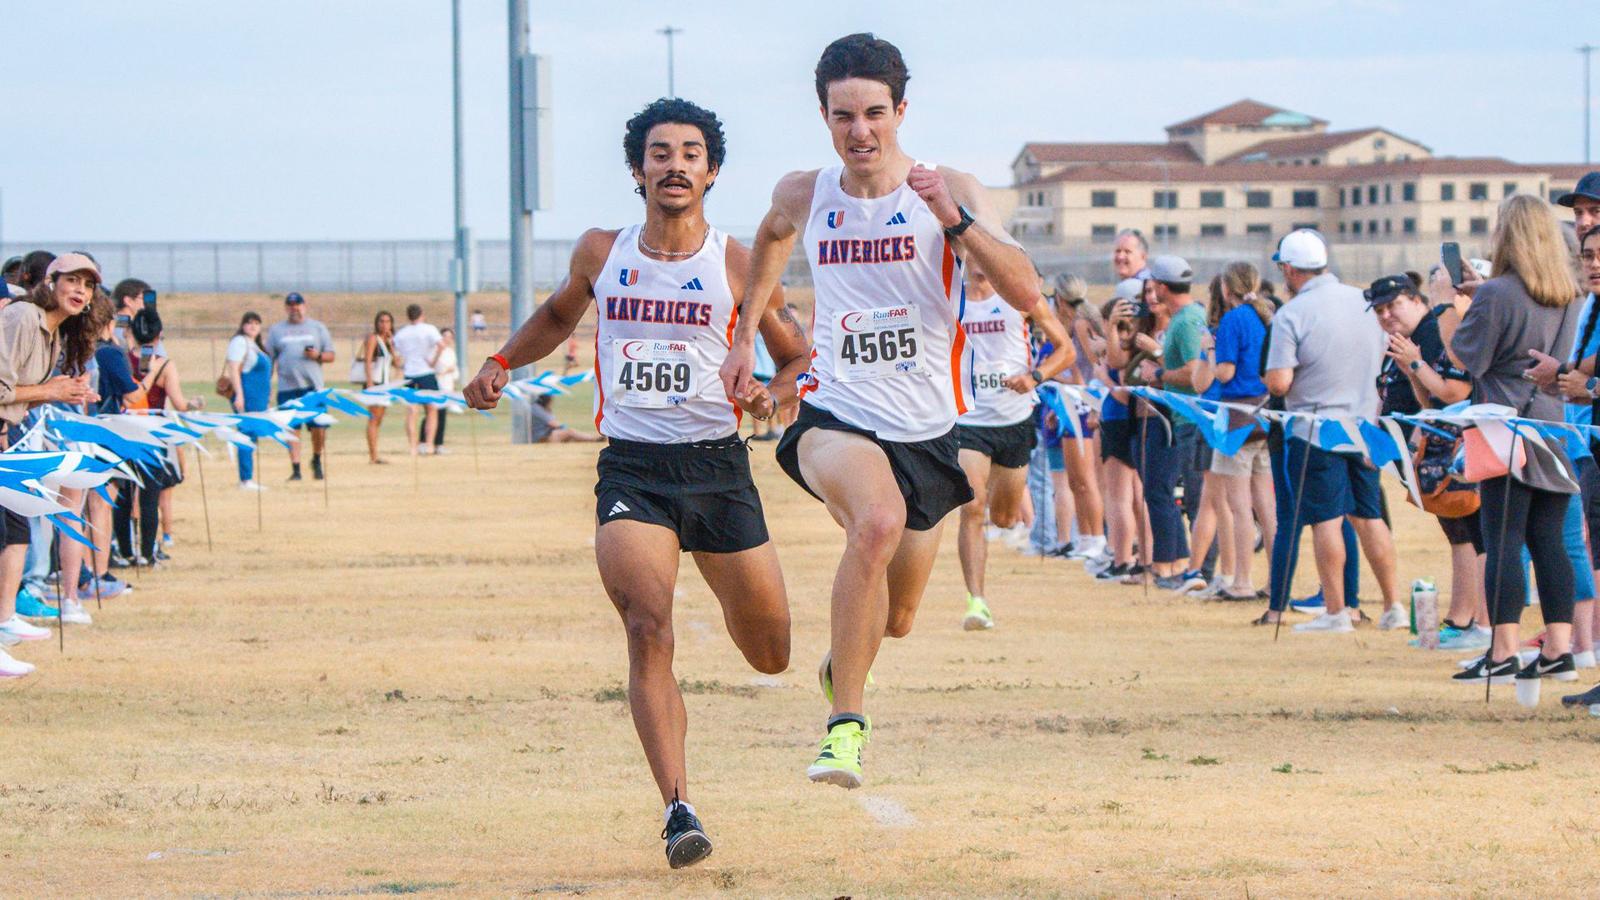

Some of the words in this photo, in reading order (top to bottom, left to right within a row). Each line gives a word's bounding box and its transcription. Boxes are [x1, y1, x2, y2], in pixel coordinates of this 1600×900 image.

[818, 235, 916, 265] MAVERICKS
[606, 296, 713, 326] MAVERICKS
[873, 308, 908, 320] RunFAR
[963, 320, 1006, 334] VERICKS
[653, 342, 687, 352] RunFAR
[841, 328, 917, 365] 4565
[619, 361, 691, 393] 4569
